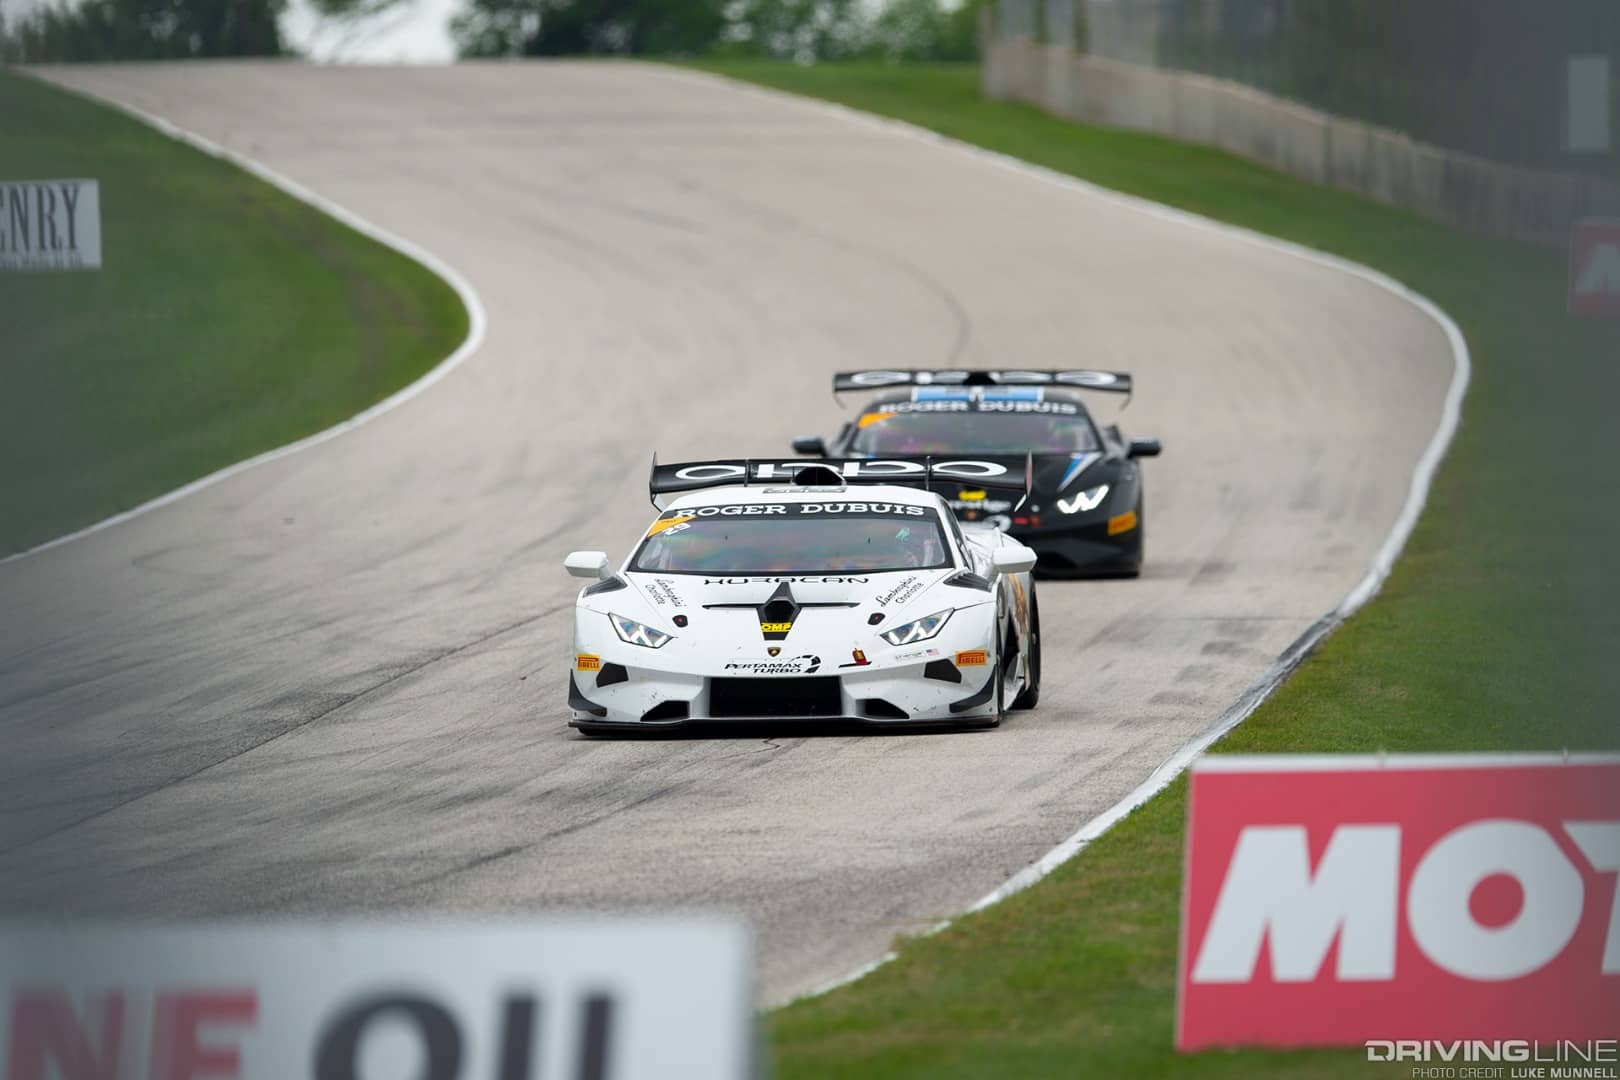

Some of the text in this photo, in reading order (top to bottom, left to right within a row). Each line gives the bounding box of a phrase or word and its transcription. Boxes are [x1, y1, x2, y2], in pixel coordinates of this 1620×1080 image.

[0, 184, 80, 252] NRY
[880, 401, 1078, 414] ROGER DUBUIS
[674, 503, 924, 518] ROGER DUBUIS
[761, 623, 791, 631] OMP
